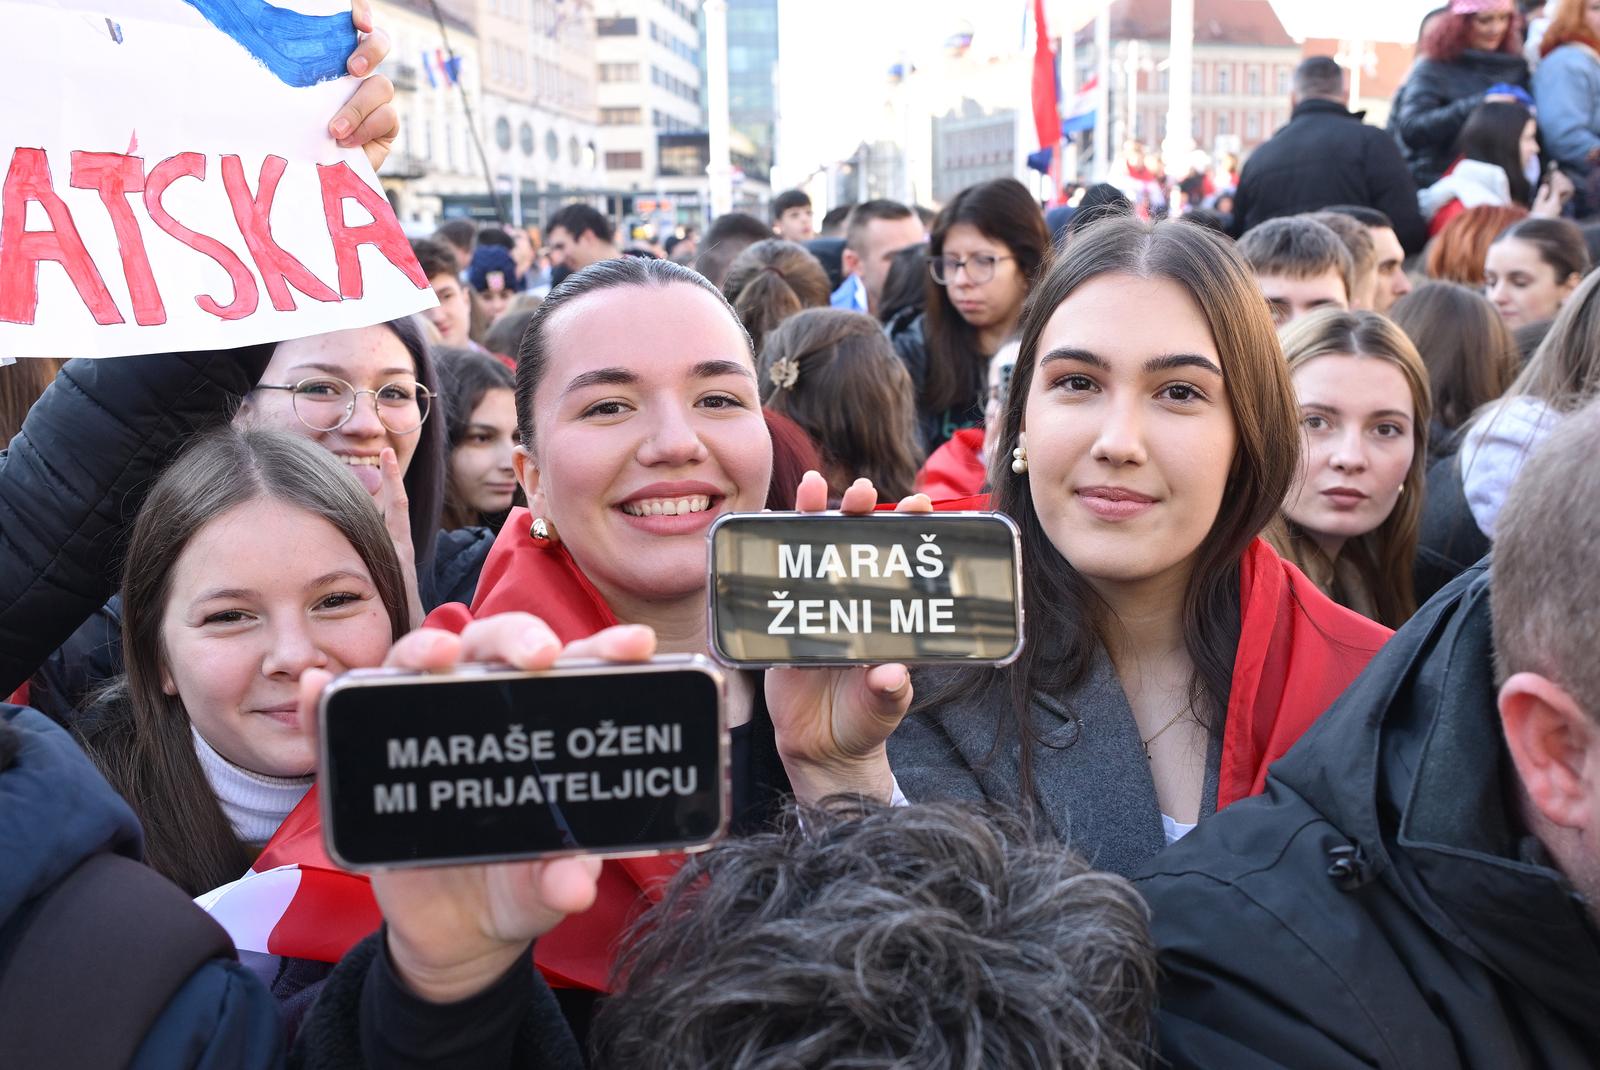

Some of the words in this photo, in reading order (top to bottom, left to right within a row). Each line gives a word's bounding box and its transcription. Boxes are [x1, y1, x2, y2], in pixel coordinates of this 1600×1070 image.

[0, 146, 431, 327] ATSKA
[777, 533, 944, 579] MARAŠ
[767, 590, 872, 635] ŽENI
[889, 598, 956, 634] ME
[387, 724, 556, 769] MARAŠE
[566, 720, 683, 759] OŽENI
[373, 783, 418, 814] MI
[429, 765, 698, 811] PRIJATELJICU
